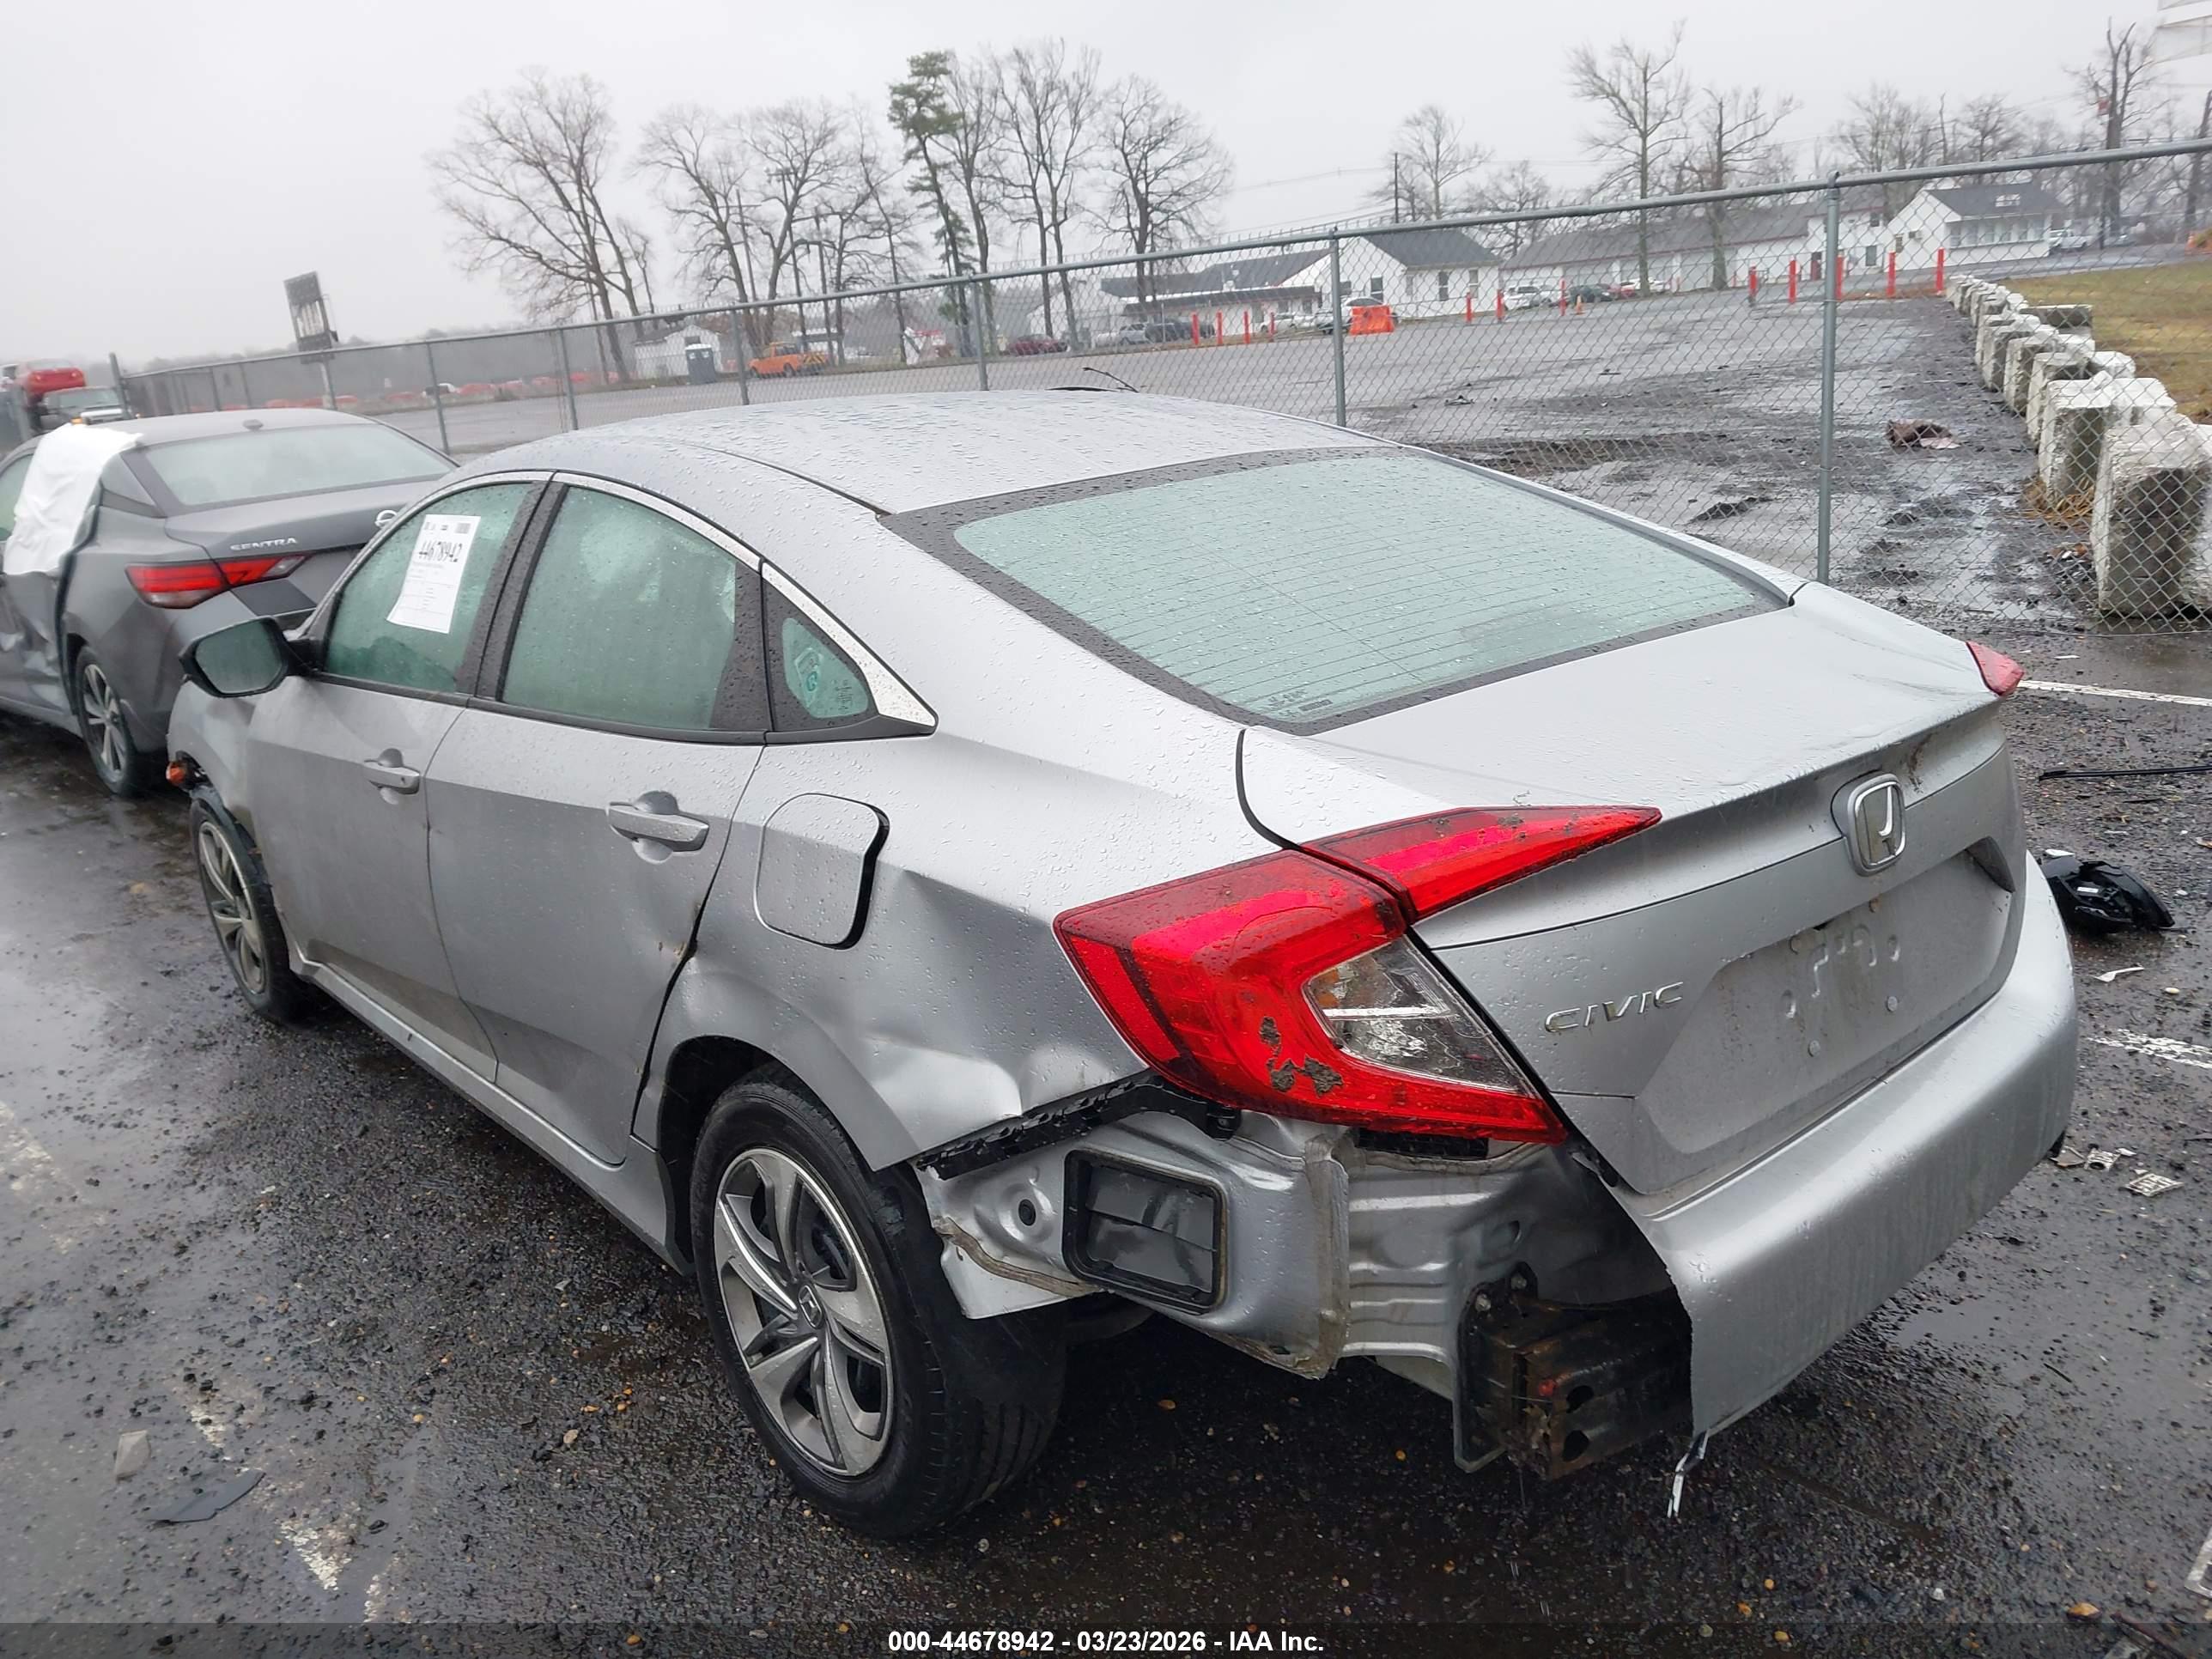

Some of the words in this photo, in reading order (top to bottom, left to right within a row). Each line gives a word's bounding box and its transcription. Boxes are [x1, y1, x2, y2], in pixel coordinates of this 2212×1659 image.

[230, 538, 297, 550] SENTRA
[418, 541, 463, 563] 44678942
[1545, 981, 1684, 1032] CIVIC
